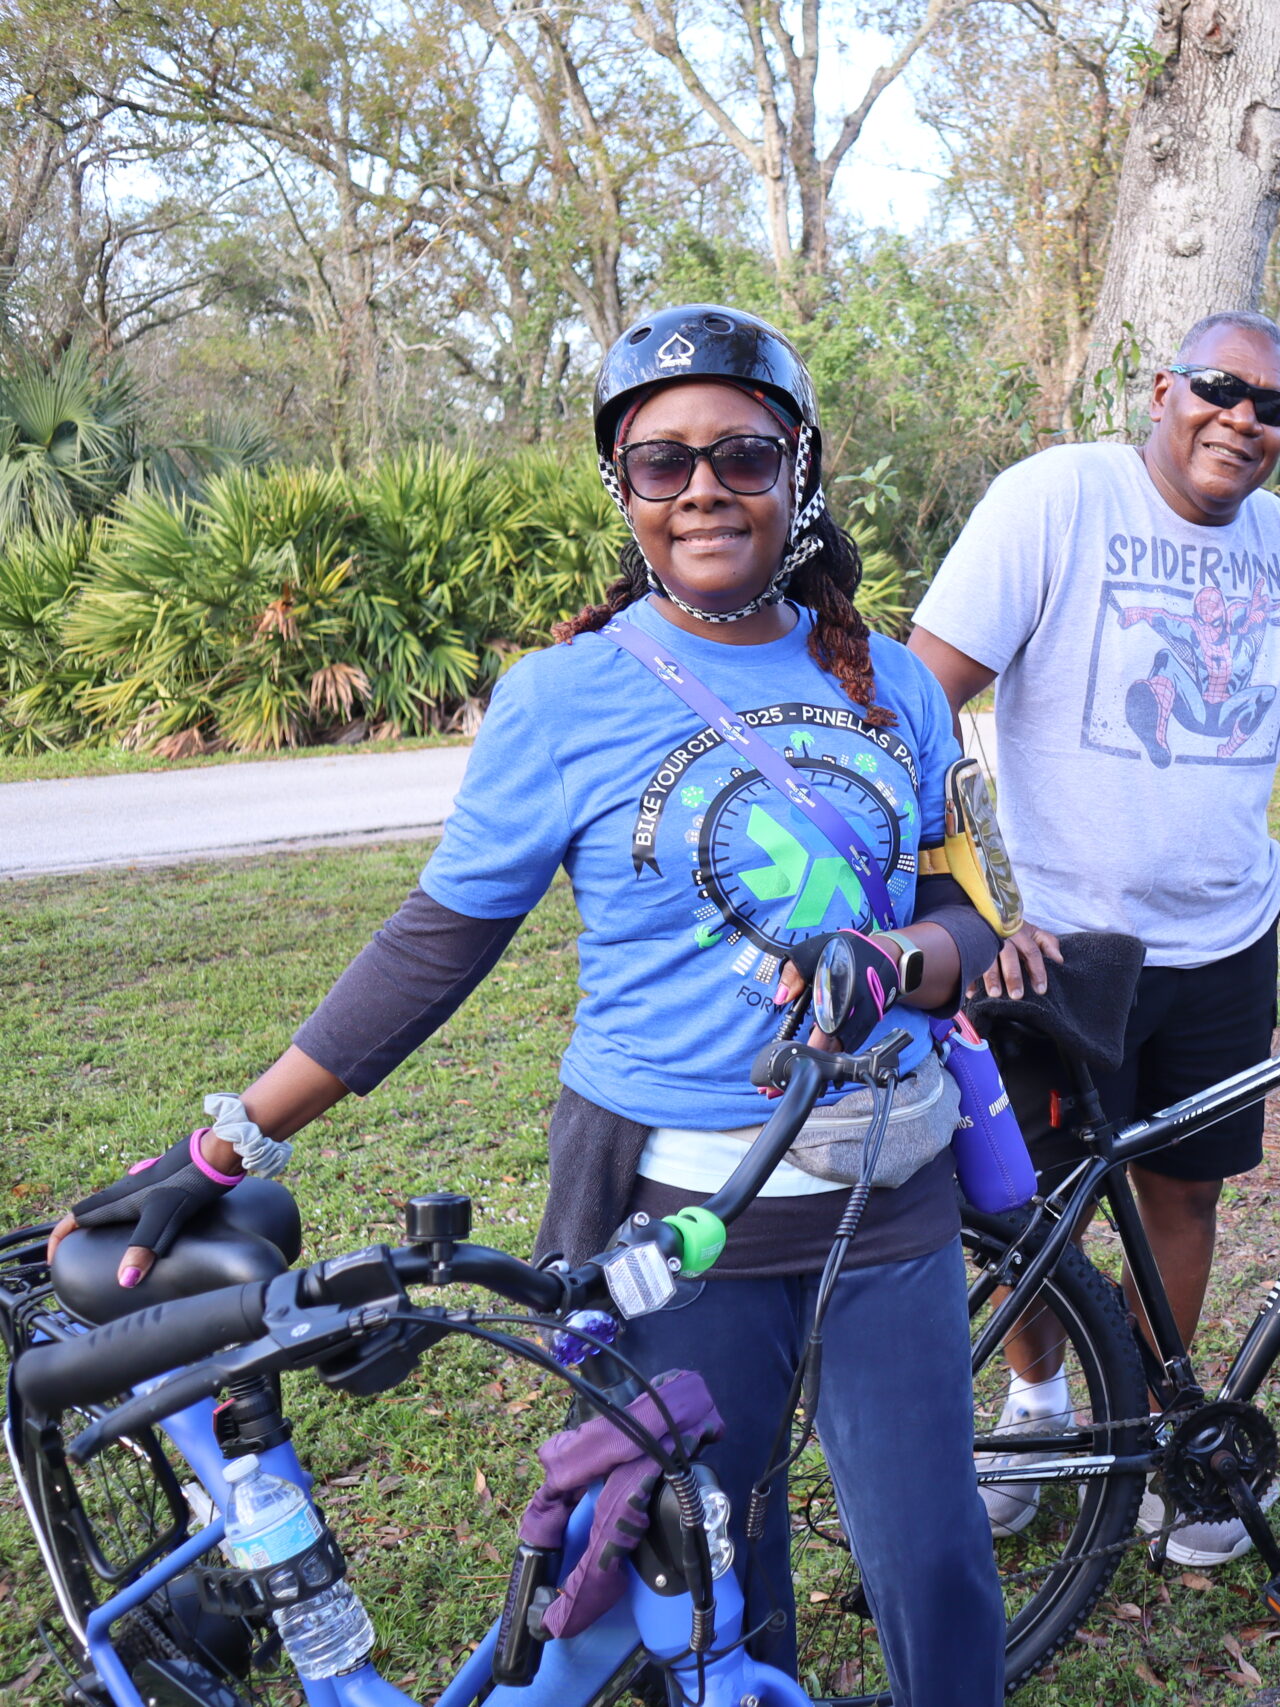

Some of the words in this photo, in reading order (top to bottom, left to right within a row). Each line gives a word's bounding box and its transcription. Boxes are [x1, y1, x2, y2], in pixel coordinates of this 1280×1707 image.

[687, 727, 722, 753] CIT
[802, 705, 891, 749] PINELLAS
[648, 749, 694, 794] YOUR
[893, 744, 918, 792] PARK
[635, 795, 662, 847] BIKE
[497, 1560, 524, 1653] KRYPTONITE
